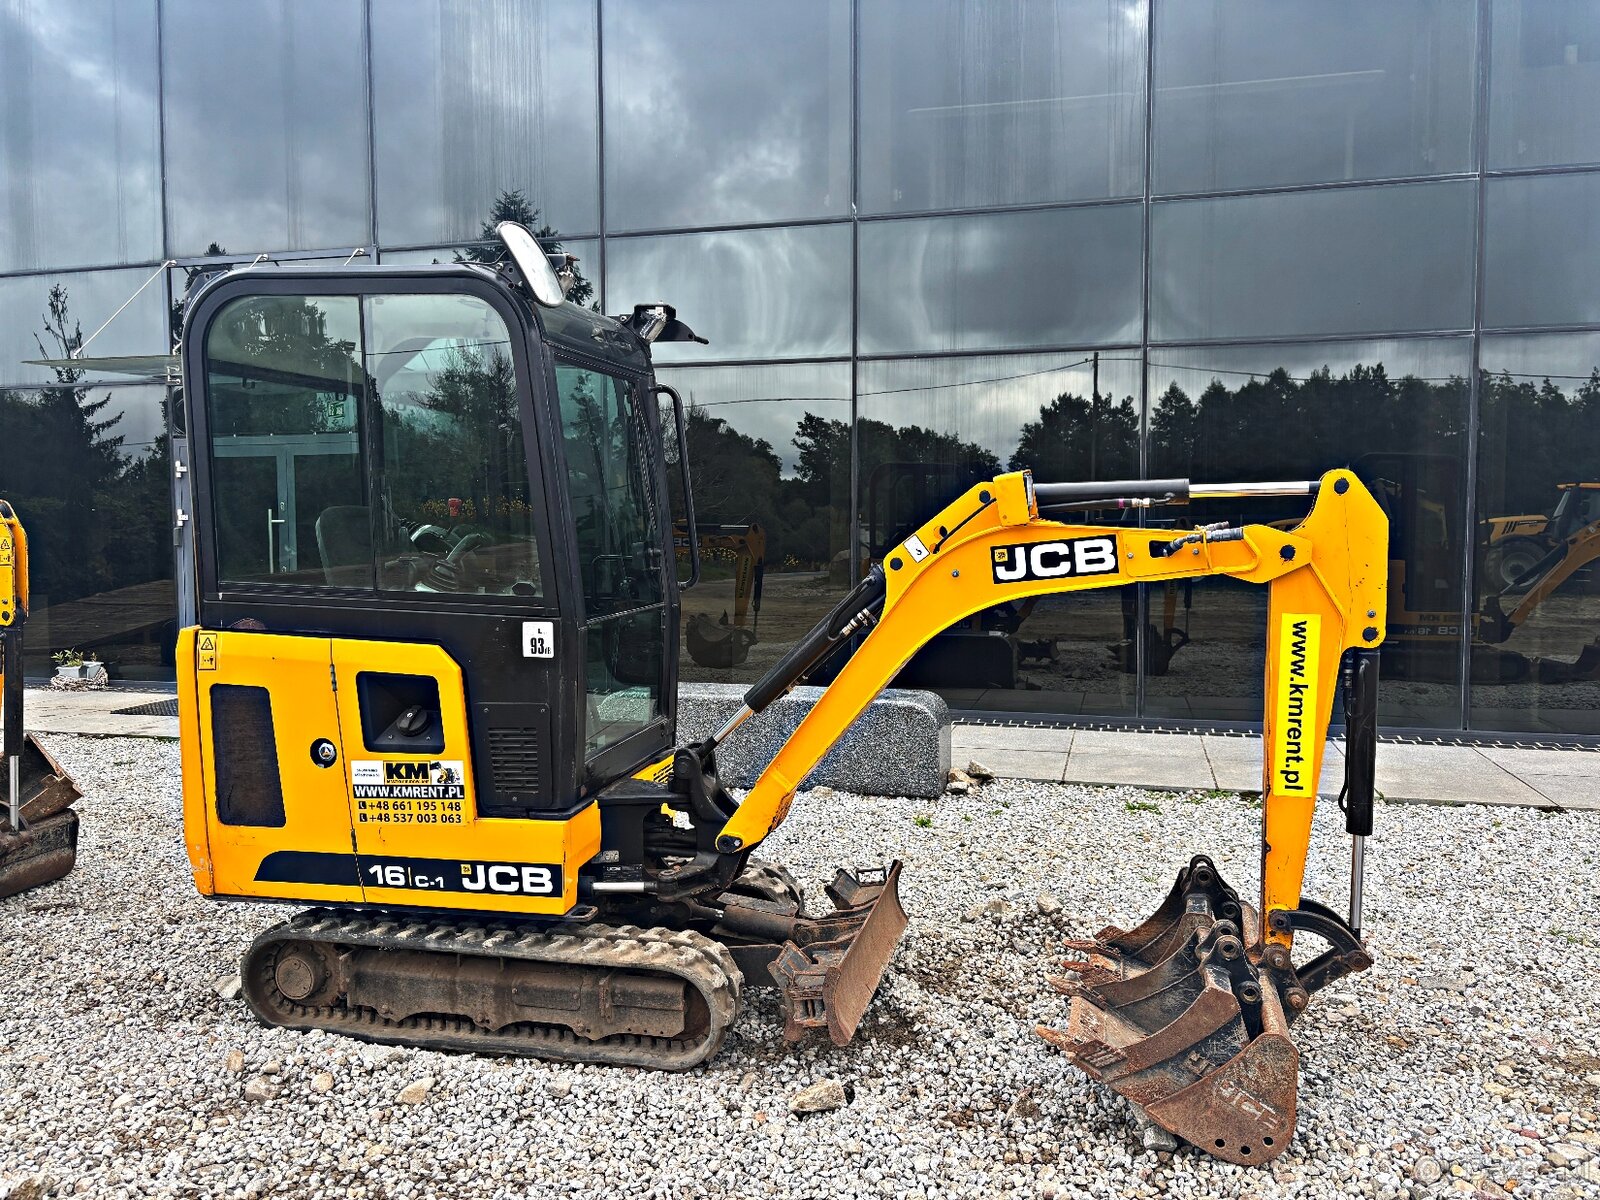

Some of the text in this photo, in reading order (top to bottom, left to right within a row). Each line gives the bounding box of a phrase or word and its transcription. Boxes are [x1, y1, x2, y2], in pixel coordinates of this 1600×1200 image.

[994, 538, 1116, 580] JCB
[1279, 620, 1309, 791] www.kmrent.pl
[385, 762, 429, 780] KM
[353, 785, 464, 798] WWW.KMRENT.PL
[369, 801, 461, 812] +48 661 195 148
[369, 813, 462, 824] +48 537 003 063
[461, 864, 553, 894] JCB
